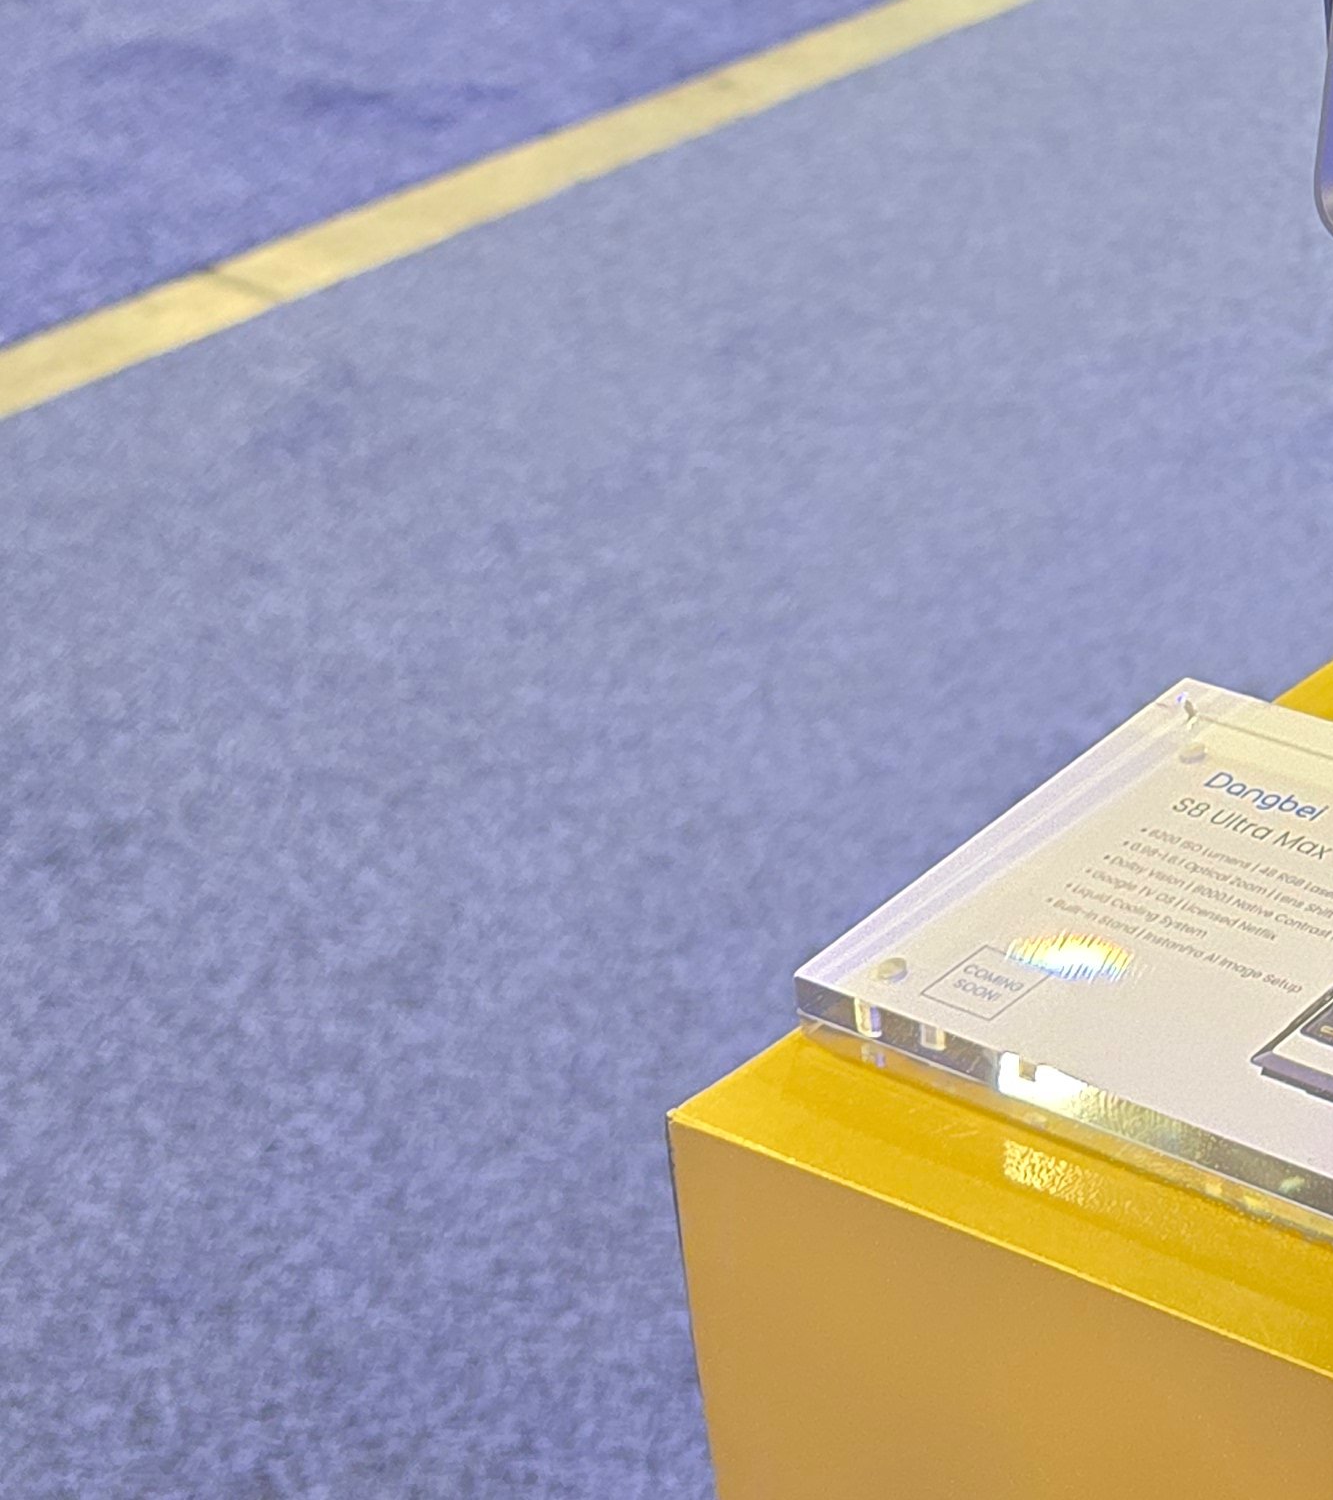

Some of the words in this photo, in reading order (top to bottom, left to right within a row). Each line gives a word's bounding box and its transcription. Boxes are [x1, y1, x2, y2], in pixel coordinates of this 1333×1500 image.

[1203, 771, 1330, 822] Dangbei
[1172, 797, 1211, 819] S8
[1210, 809, 1273, 841] Ultra
[1273, 831, 1332, 860] Max
[1184, 861, 1232, 882] Optical
[1229, 876, 1268, 895] Zoom
[1274, 891, 1305, 908] Lens
[1202, 847, 1252, 869] Lumens
[1276, 872, 1306, 887] RGB
[1072, 883, 1113, 903] Liquid
[1111, 898, 1160, 923] Cooling
[1158, 914, 1208, 939] System
[1092, 870, 1139, 891] Google
[1138, 885, 1158, 897] TV
[1155, 892, 1177, 904] OS
[1180, 899, 1240, 928] Licensed
[1237, 920, 1277, 941] Netflix
[1109, 855, 1149, 874] Dolby
[1148, 868, 1186, 888] Vision
[1231, 897, 1274, 918] Native
[1274, 912, 1332, 938] Contrast
[1053, 899, 1100, 921] Built-in
[1098, 915, 1139, 935] Stand
[1203, 952, 1221, 964] AI
[1218, 957, 1263, 979] Image
[1262, 973, 1303, 994] Setup
[962, 963, 1025, 992] COMING
